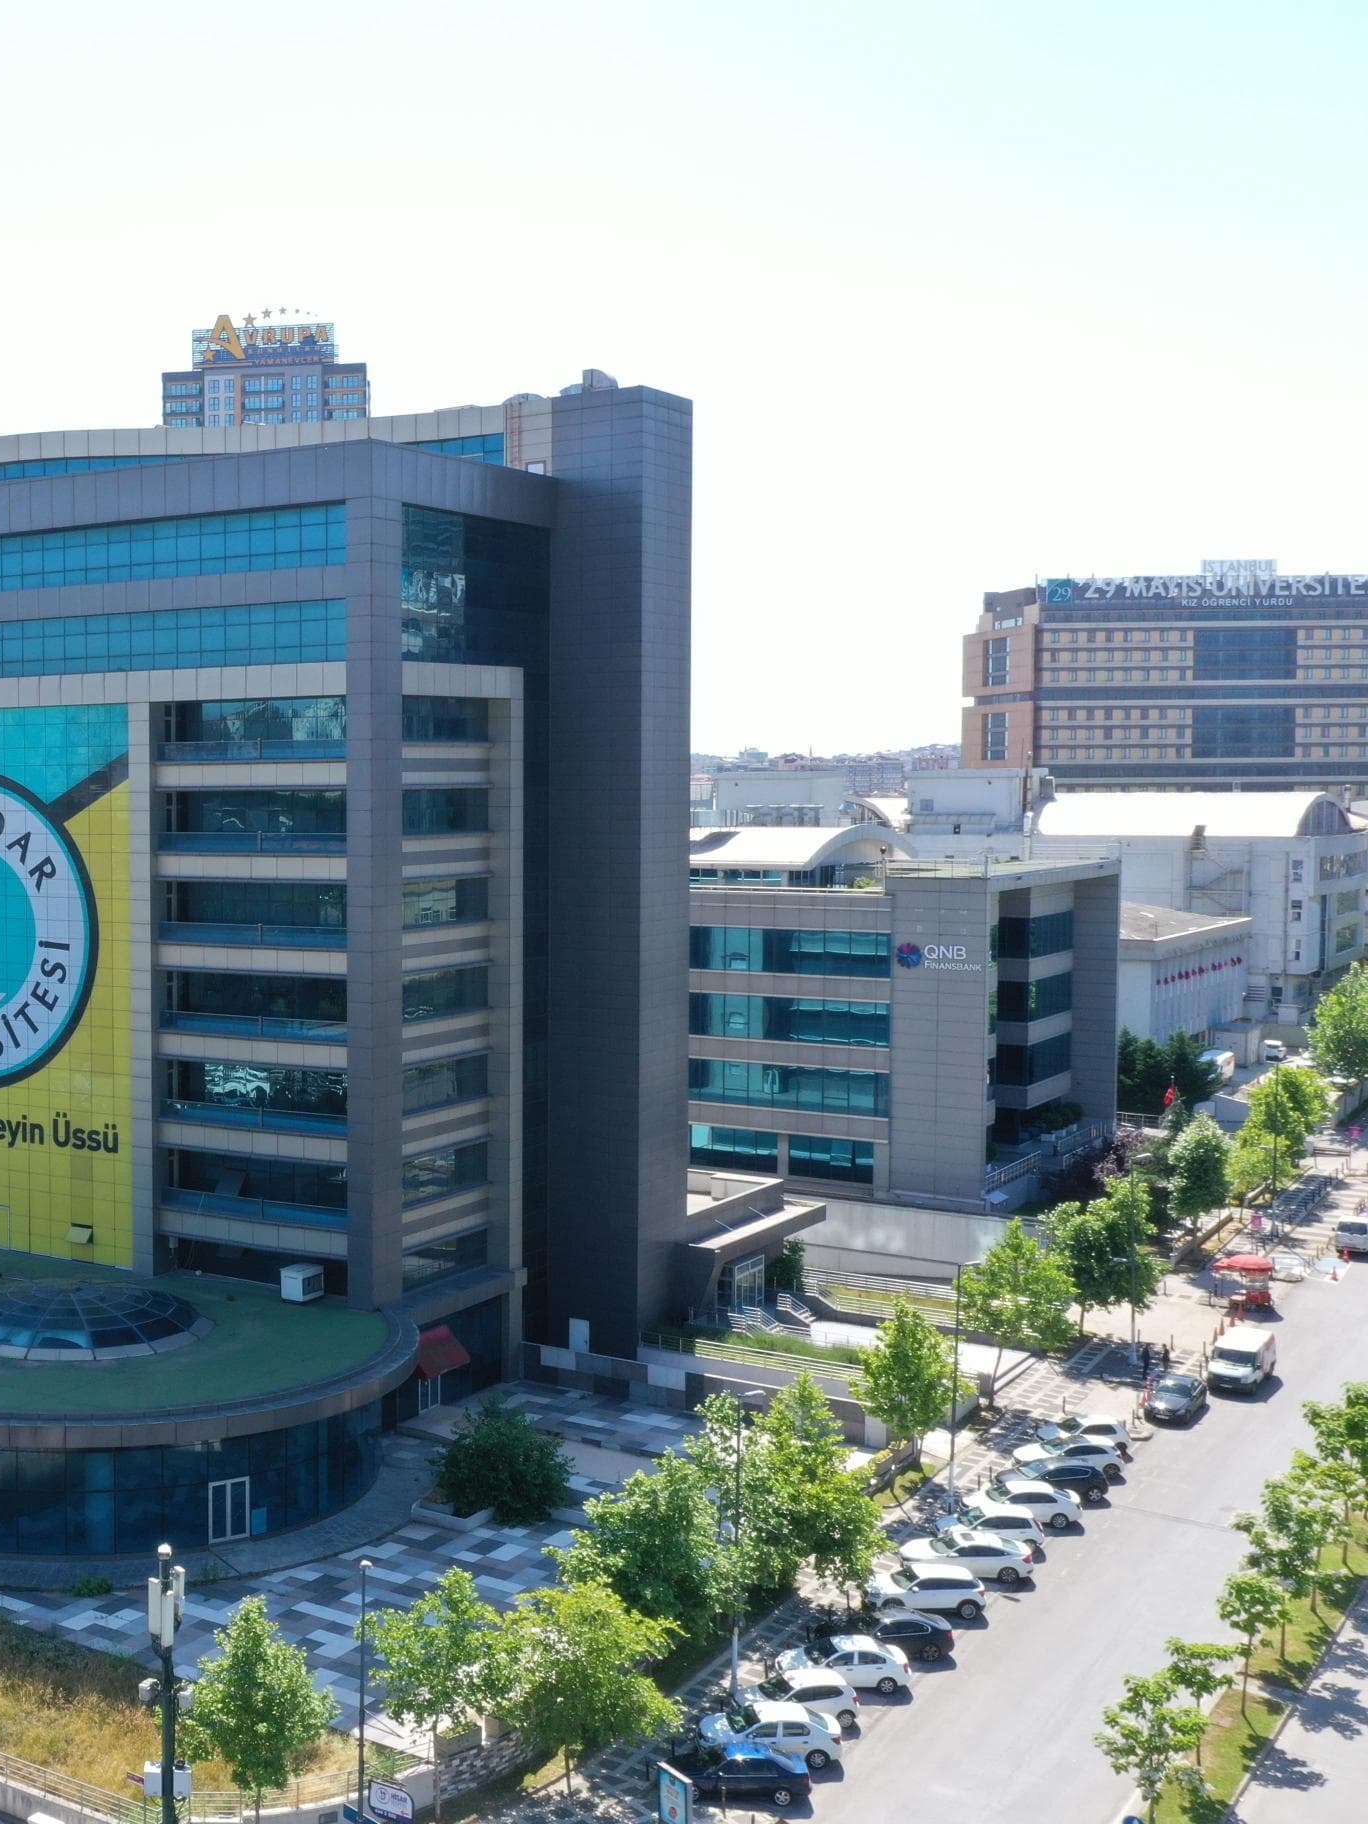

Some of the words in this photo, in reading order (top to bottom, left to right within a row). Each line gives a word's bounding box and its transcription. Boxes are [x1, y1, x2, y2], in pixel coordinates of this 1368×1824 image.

[205, 314, 330, 360] AVRUPA
[1053, 586, 1071, 602] 29
[1084, 577, 1118, 598] 29
[1124, 575, 1202, 598] MAYIS
[1210, 571, 1368, 597] ÜNİVERSİTE
[1182, 599, 1198, 607] KIZ
[1254, 597, 1294, 606] YURDU
[924, 944, 967, 960] QNB
[52, 1111, 120, 1155] Üssü
